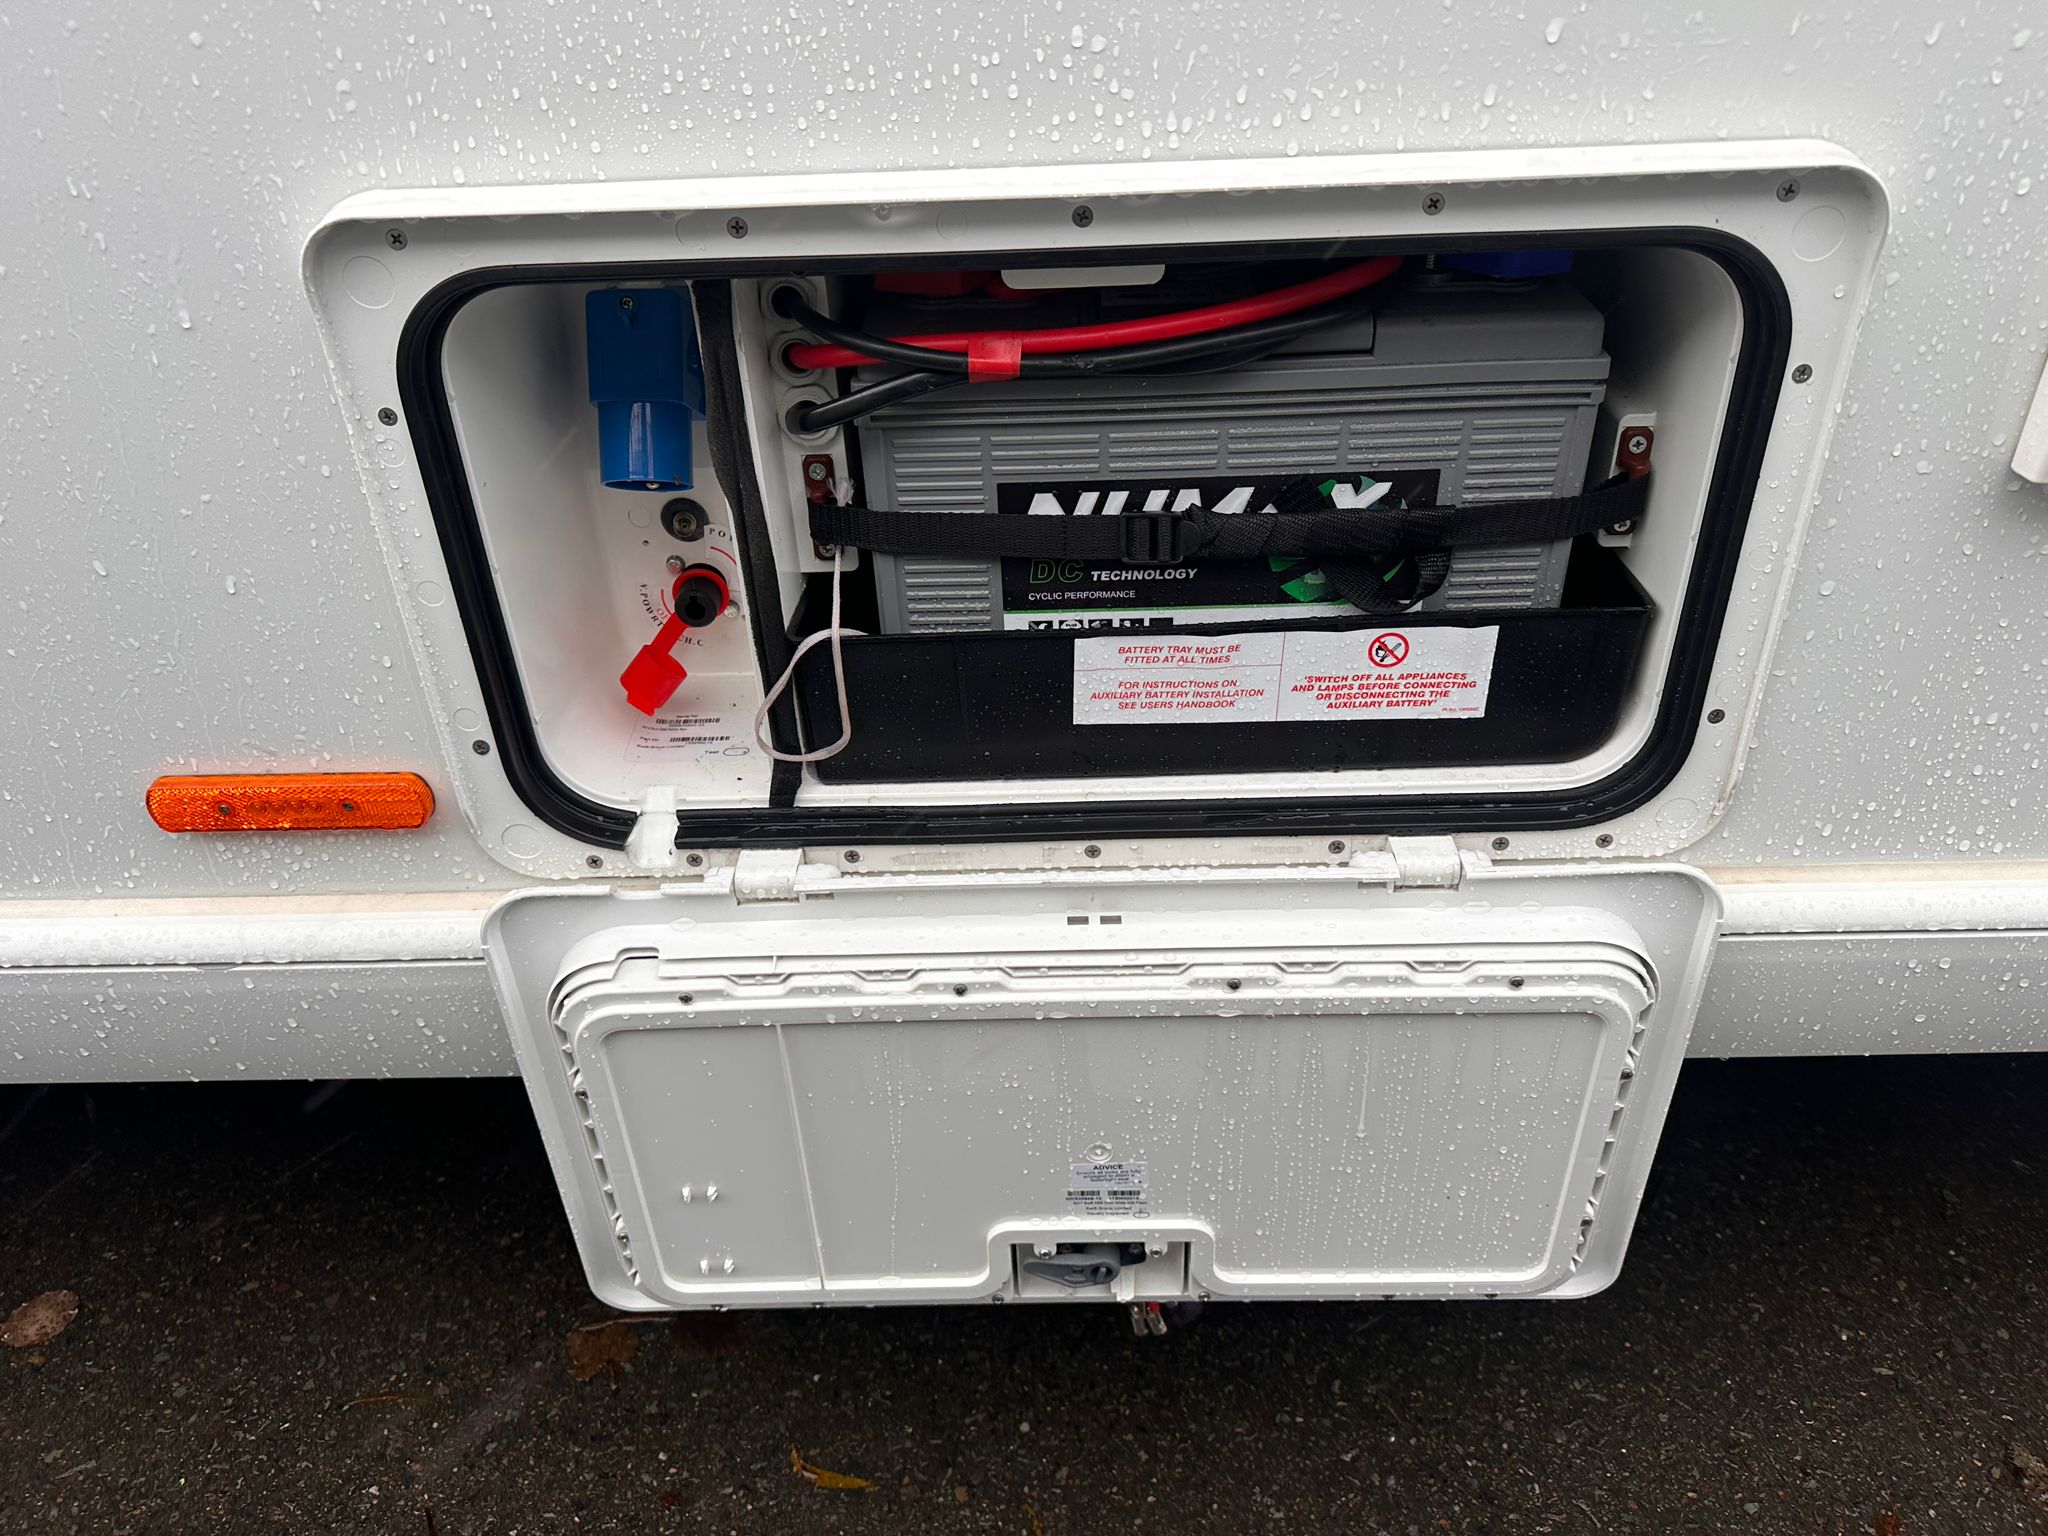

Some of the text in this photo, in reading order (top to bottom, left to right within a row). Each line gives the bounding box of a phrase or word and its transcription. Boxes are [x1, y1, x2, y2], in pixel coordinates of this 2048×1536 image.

[709, 528, 732, 542] PO
[1030, 558, 1198, 584] DC TECHNOLOGY
[1028, 590, 1136, 600] CYCLIC PERFORMANCE
[1118, 644, 1241, 654] BATTERY TRAY MUST BE
[1200, 655, 1231, 664] TIMES
[1142, 680, 1218, 689] INSTRUCTIONS
[1403, 681, 1477, 689] CONNECTING
[1090, 689, 1264, 700] AUXILIARY BATTERY INSTALLATION
[1334, 691, 1426, 700] DISCONNECTING
[1176, 700, 1236, 708] HANDBOOK
[1326, 701, 1384, 709] AUXILIARY
